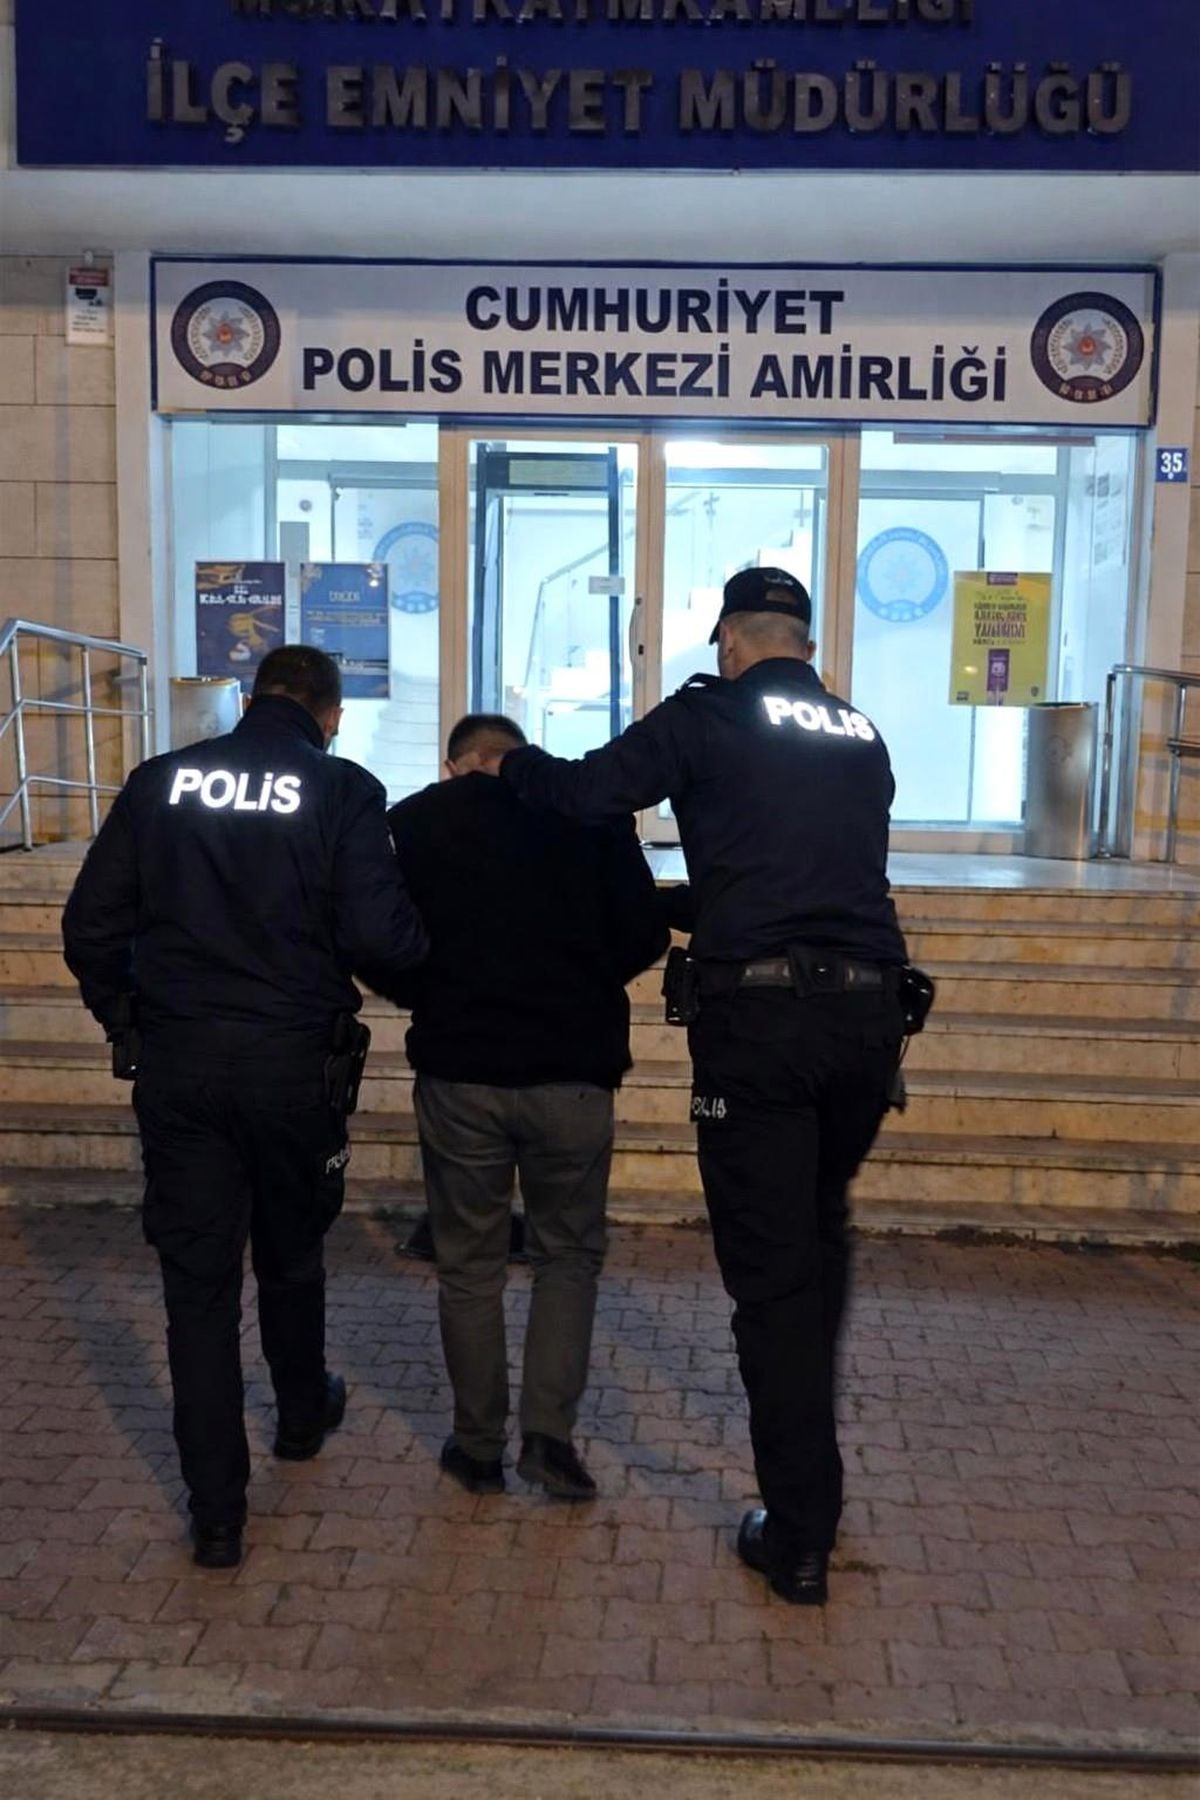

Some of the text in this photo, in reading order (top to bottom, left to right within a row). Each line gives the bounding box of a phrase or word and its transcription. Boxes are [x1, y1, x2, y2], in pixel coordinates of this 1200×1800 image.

[146, 38, 1132, 142] İLÇE EMNİYET MÜDÜRLÜĞÜ
[466, 277, 844, 335] CUMHURİYET
[303, 339, 462, 392] POLİS
[483, 342, 730, 397] MERKEZİ
[750, 343, 1006, 402] AMİRLİĞİ
[1160, 452, 1183, 473] 35
